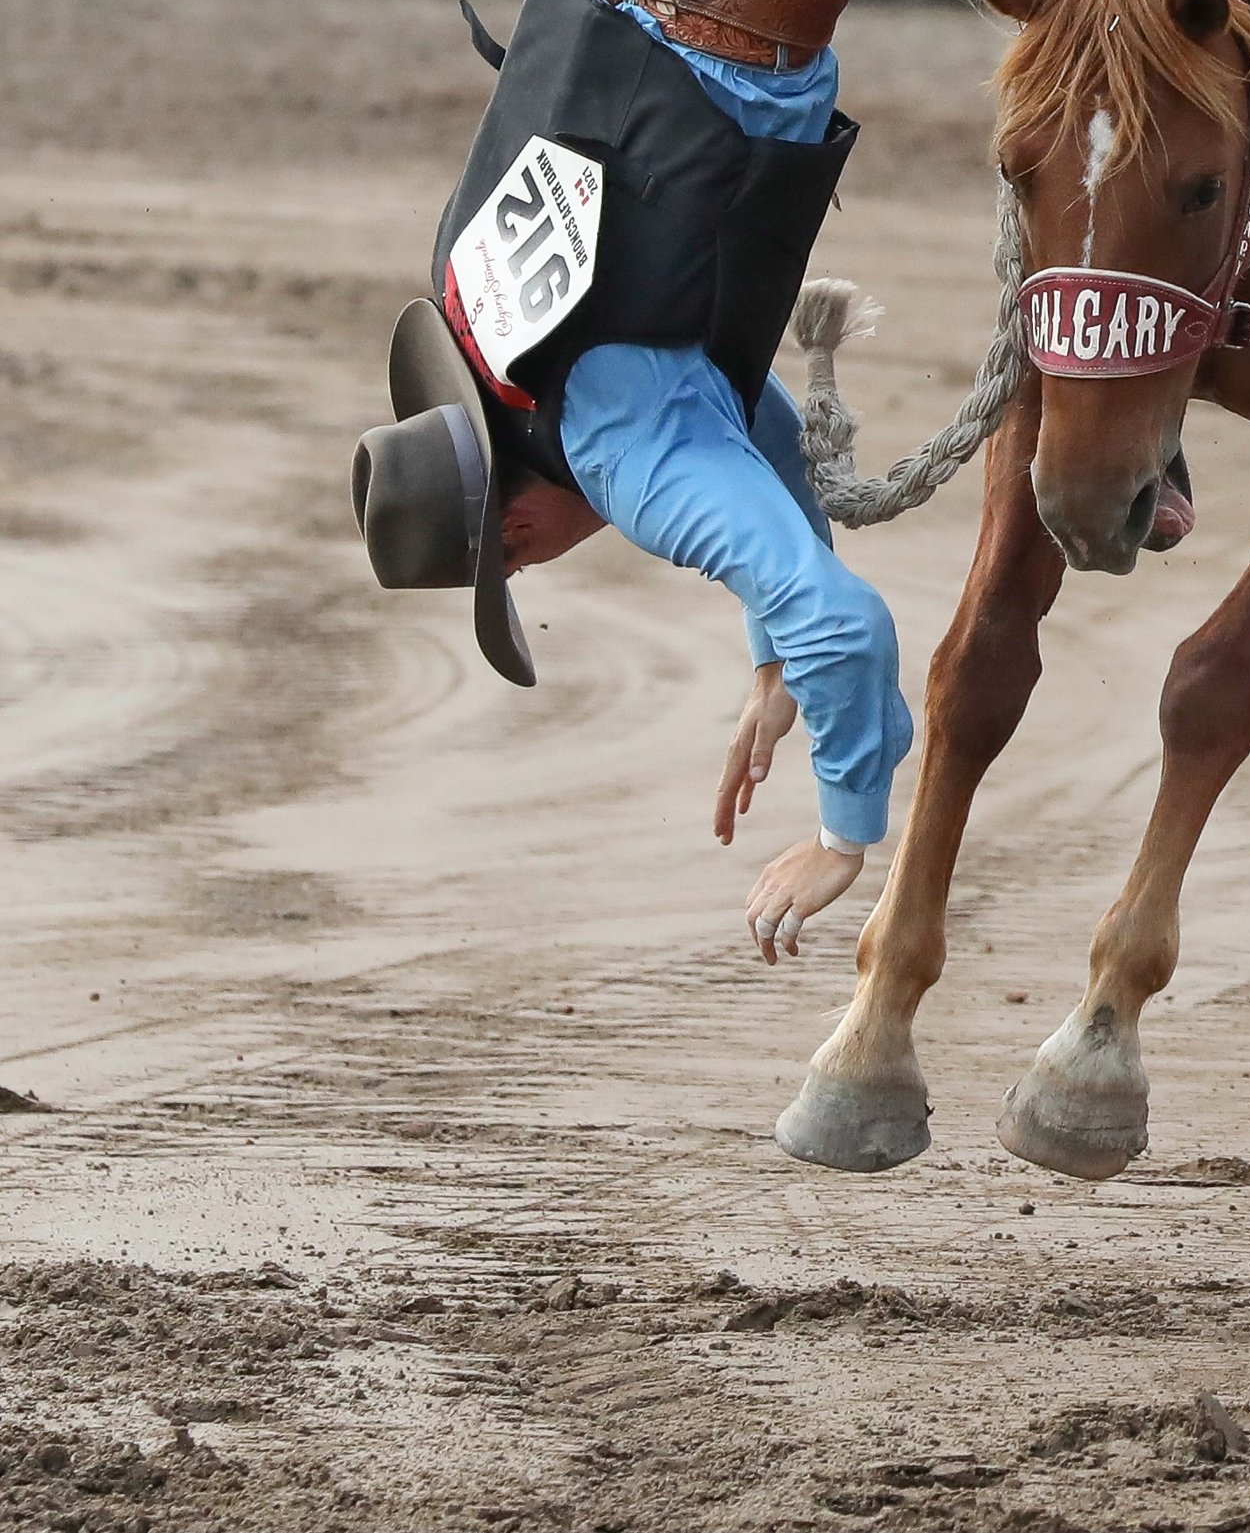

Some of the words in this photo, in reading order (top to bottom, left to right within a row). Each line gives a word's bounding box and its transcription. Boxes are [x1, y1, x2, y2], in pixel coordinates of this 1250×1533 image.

[536, 148, 557, 186] DARK
[582, 165, 598, 195] 2021
[551, 181, 572, 220] AFTER
[475, 238, 500, 293] Stampede
[496, 165, 571, 324] 912
[564, 216, 588, 269] BRONCS
[494, 293, 513, 338] Calgary
[1030, 289, 1187, 360] CALGARY
